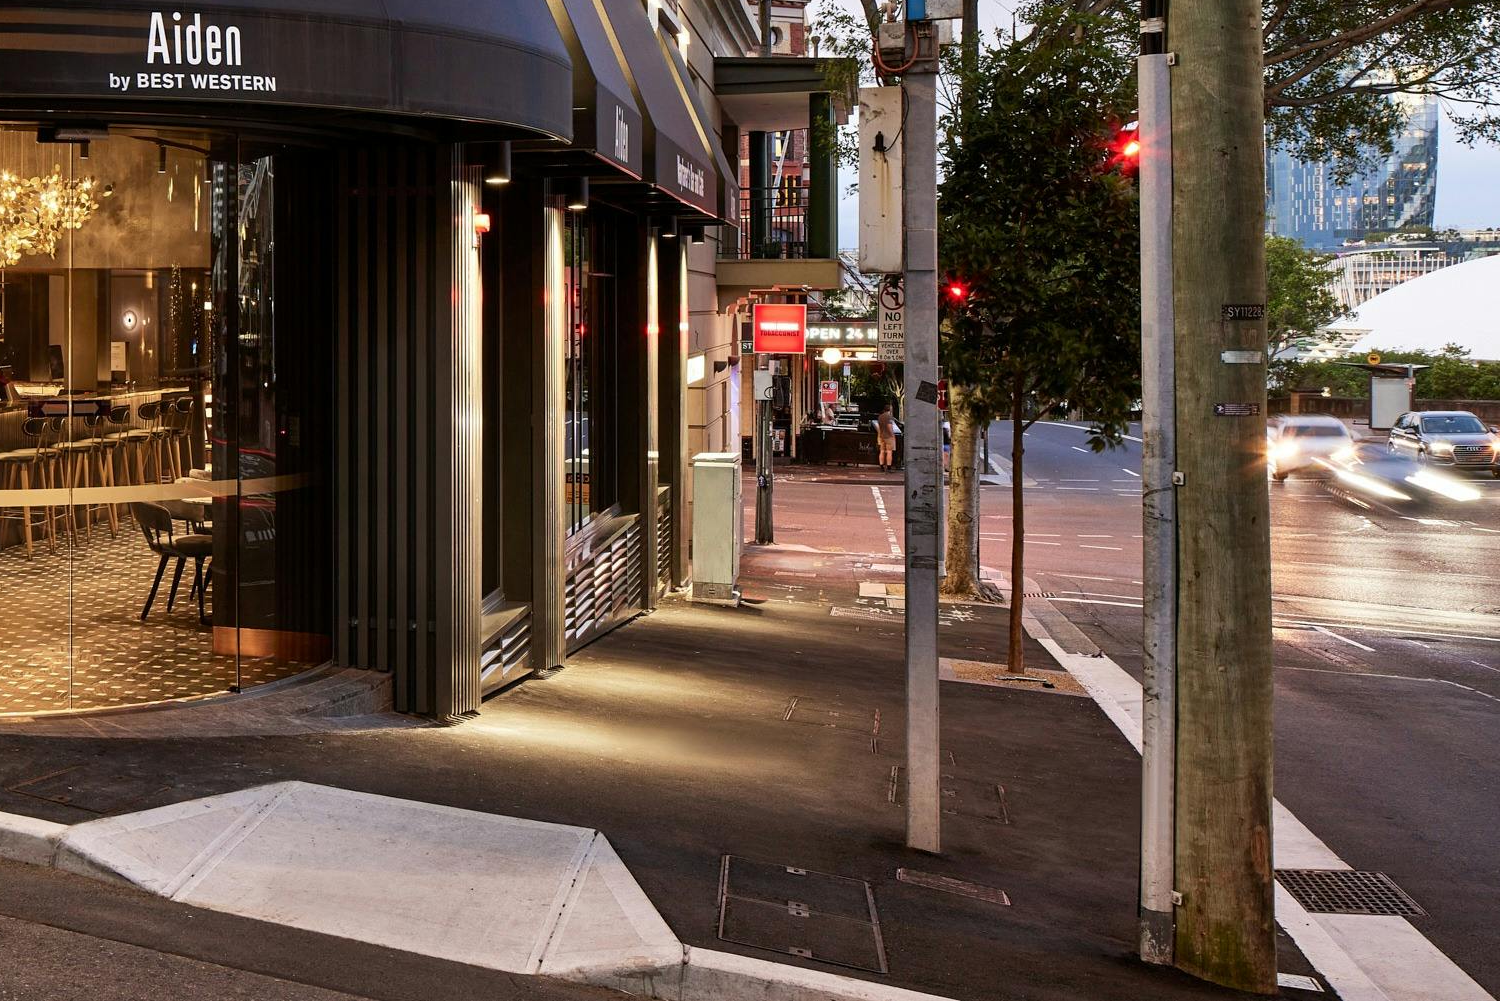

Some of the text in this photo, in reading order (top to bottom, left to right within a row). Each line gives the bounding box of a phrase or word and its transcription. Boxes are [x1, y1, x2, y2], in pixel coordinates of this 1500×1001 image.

[147, 11, 242, 66] Aiden
[109, 73, 277, 92] by BEST WESTERN
[614, 104, 629, 164] Aiden
[885, 312, 901, 321] NO
[845, 327, 865, 339] 24
[883, 323, 903, 331] LEFT
[742, 342, 753, 350] ST
